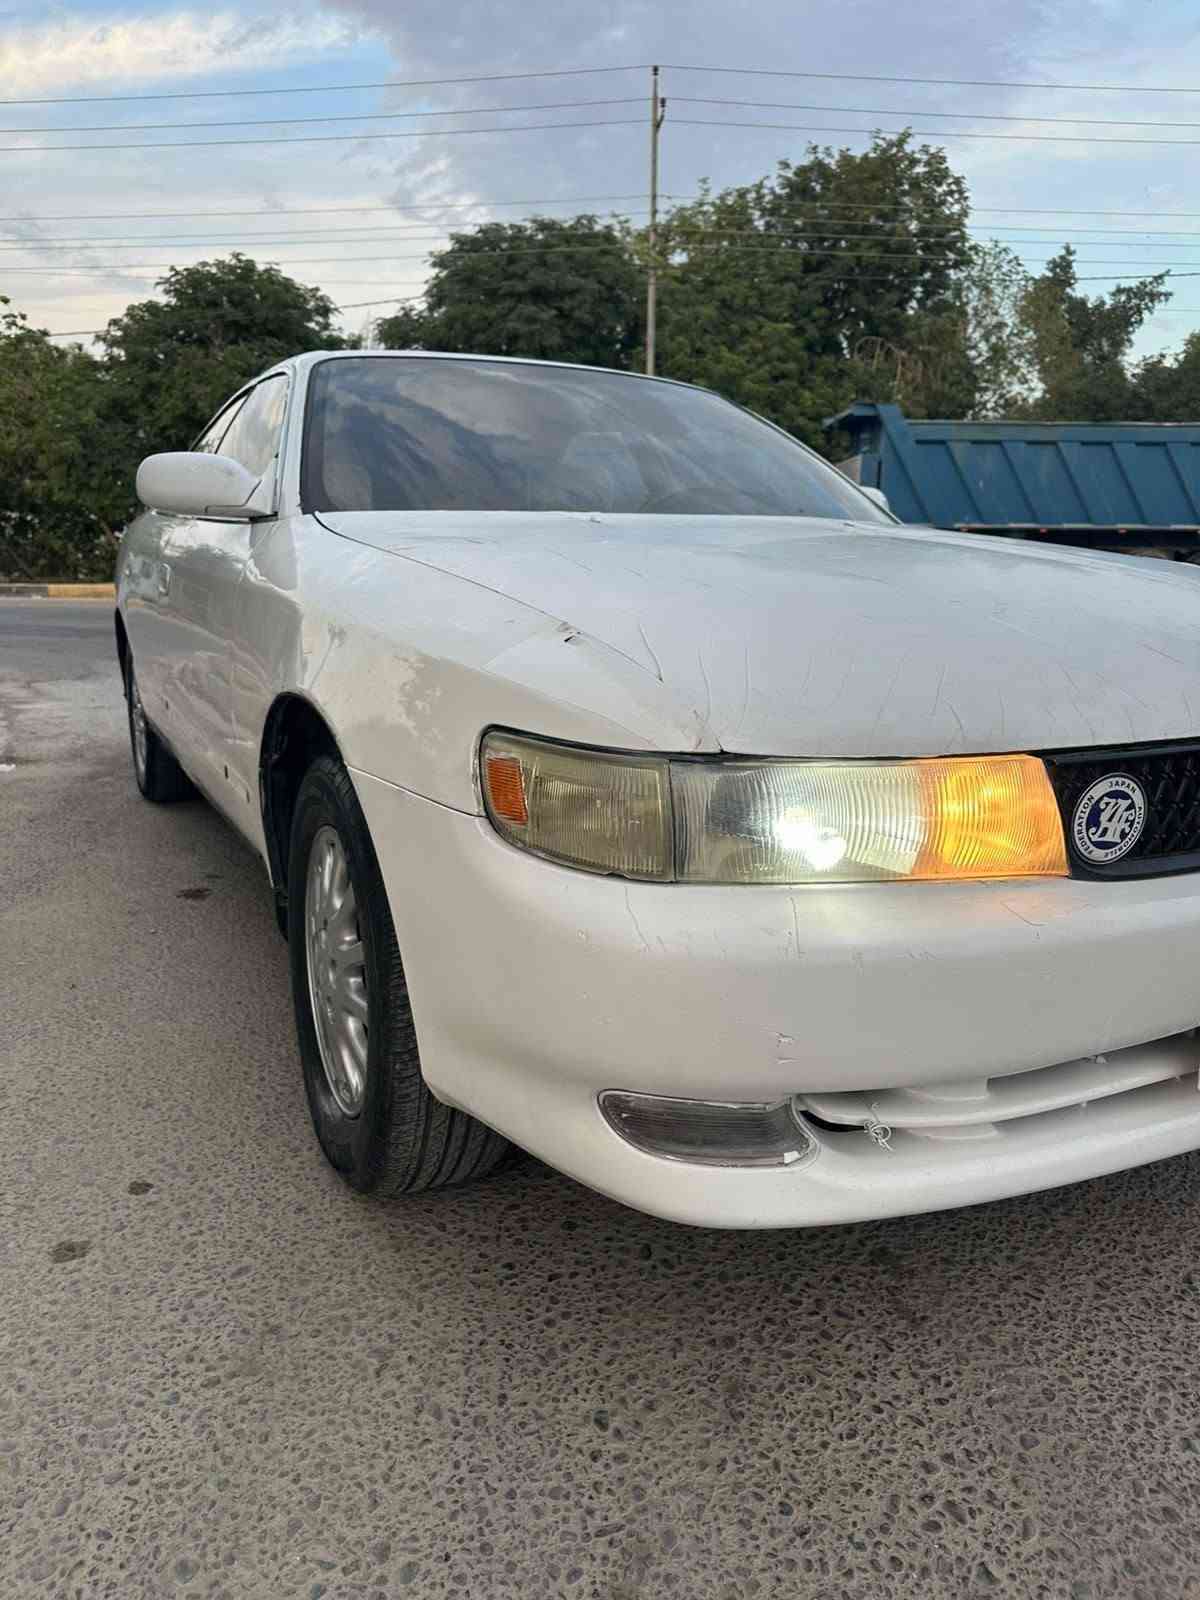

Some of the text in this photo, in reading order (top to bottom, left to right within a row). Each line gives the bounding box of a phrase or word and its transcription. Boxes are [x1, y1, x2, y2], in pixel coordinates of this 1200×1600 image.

[1077, 781, 1143, 858] JAPAN AUTOMOBILE FEDERATION
